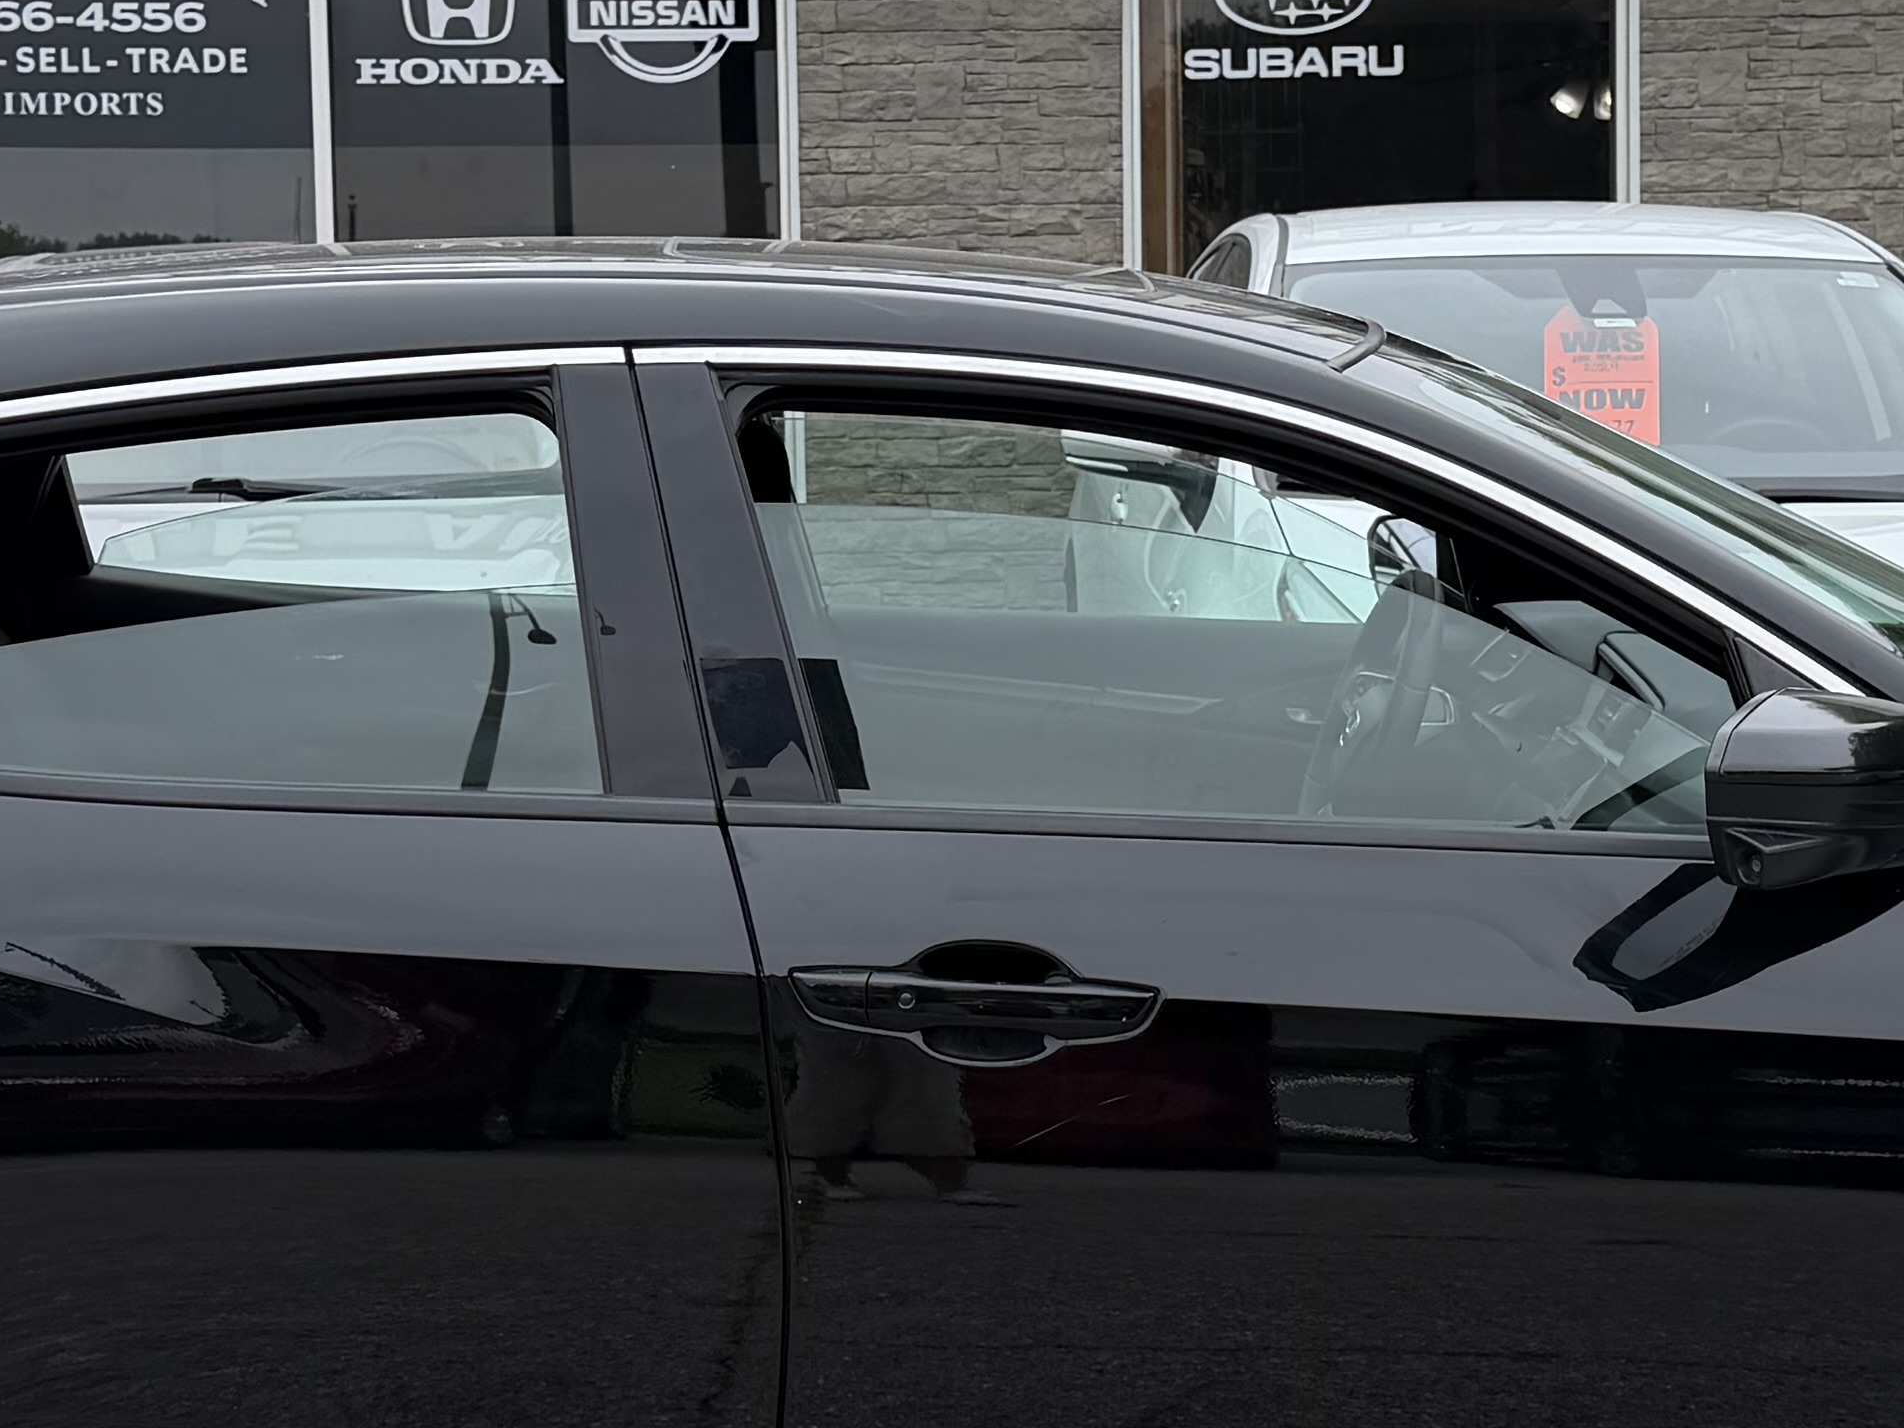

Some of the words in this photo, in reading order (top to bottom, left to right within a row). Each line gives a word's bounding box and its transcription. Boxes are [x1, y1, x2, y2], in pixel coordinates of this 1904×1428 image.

[589, 0, 736, 27] NISSAN
[354, 57, 565, 85] HONDA
[1183, 44, 1405, 80] SUBARU
[2, 91, 165, 117] IMPORTS
[1559, 330, 1645, 354] WAS
[1558, 388, 1646, 411] NOW
